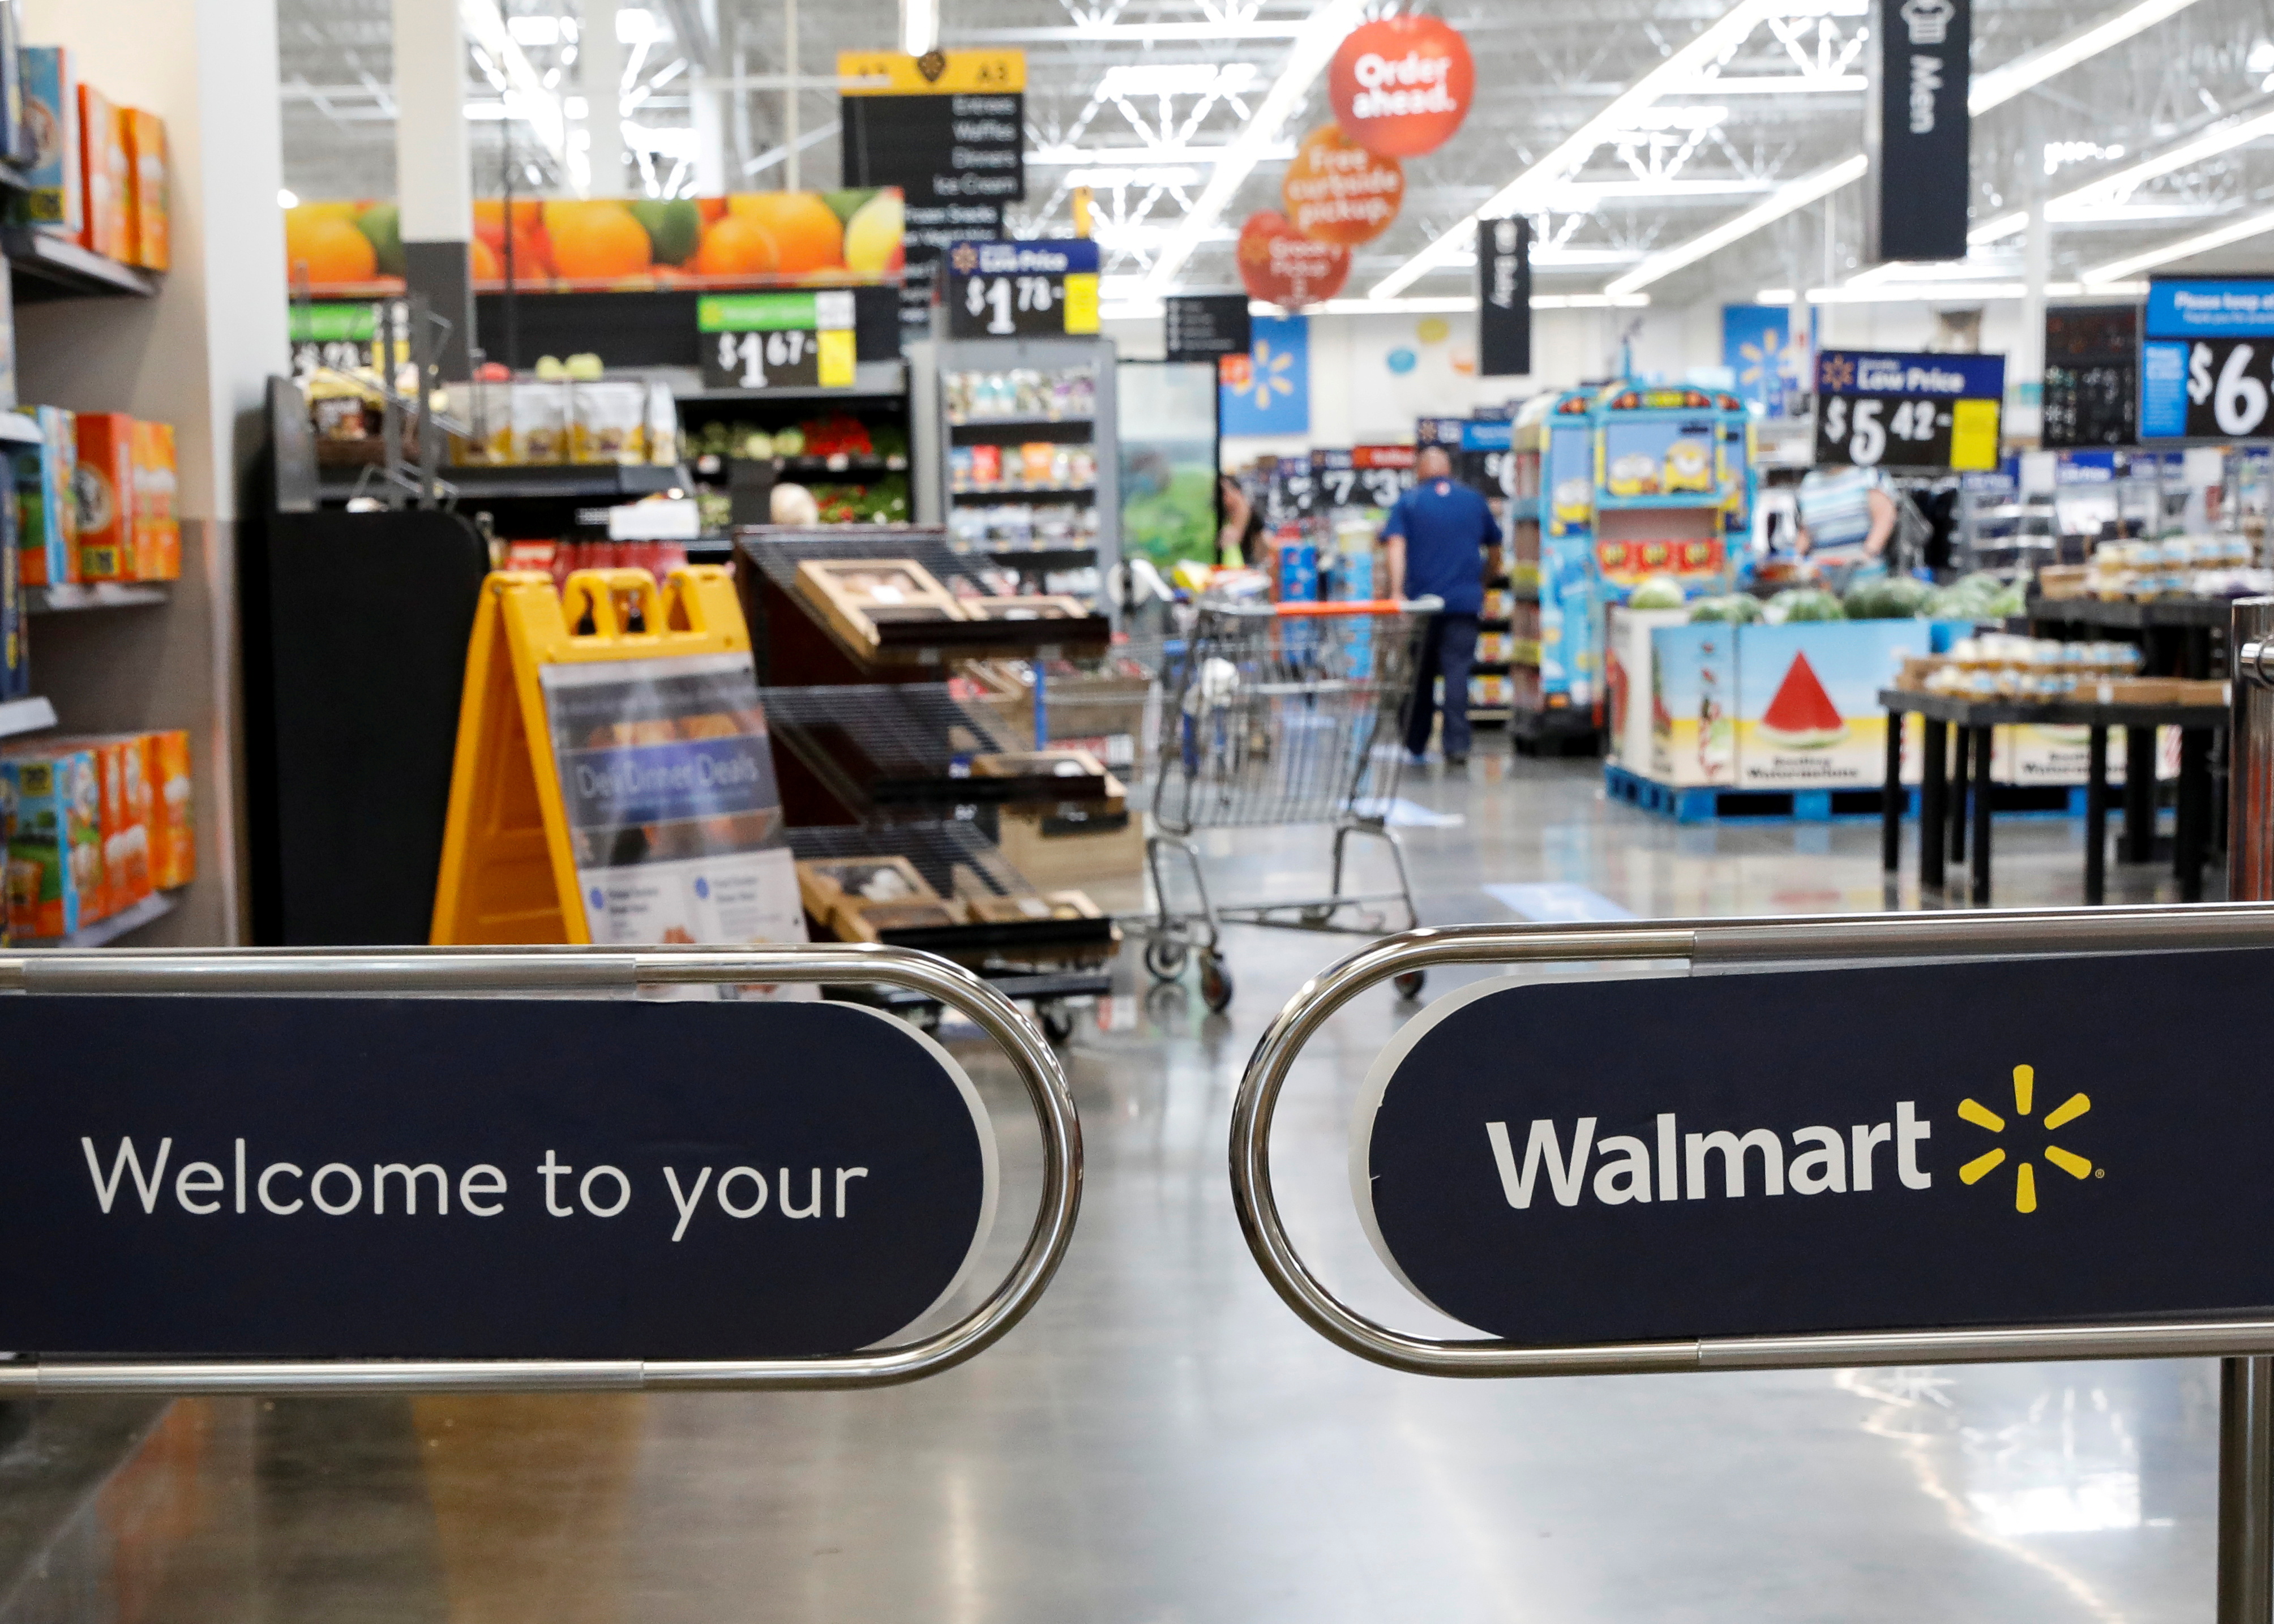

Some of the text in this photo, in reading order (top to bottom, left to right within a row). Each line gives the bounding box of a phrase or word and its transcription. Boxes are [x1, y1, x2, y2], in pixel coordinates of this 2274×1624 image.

[1355, 51, 1453, 88] Order
[1353, 85, 1457, 119] ahead.
[1909, 54, 1943, 134] Men
[1309, 145, 1368, 172] Free
[933, 173, 1016, 196] Ice Cream
[1288, 168, 1397, 200] curbside
[1019, 249, 1069, 272] Price
[1857, 367, 1965, 393] Low Price
[696, 751, 760, 788] Deals
[1485, 1101, 1932, 1209] Walmart
[82, 1136, 868, 1242] Welcome to your
